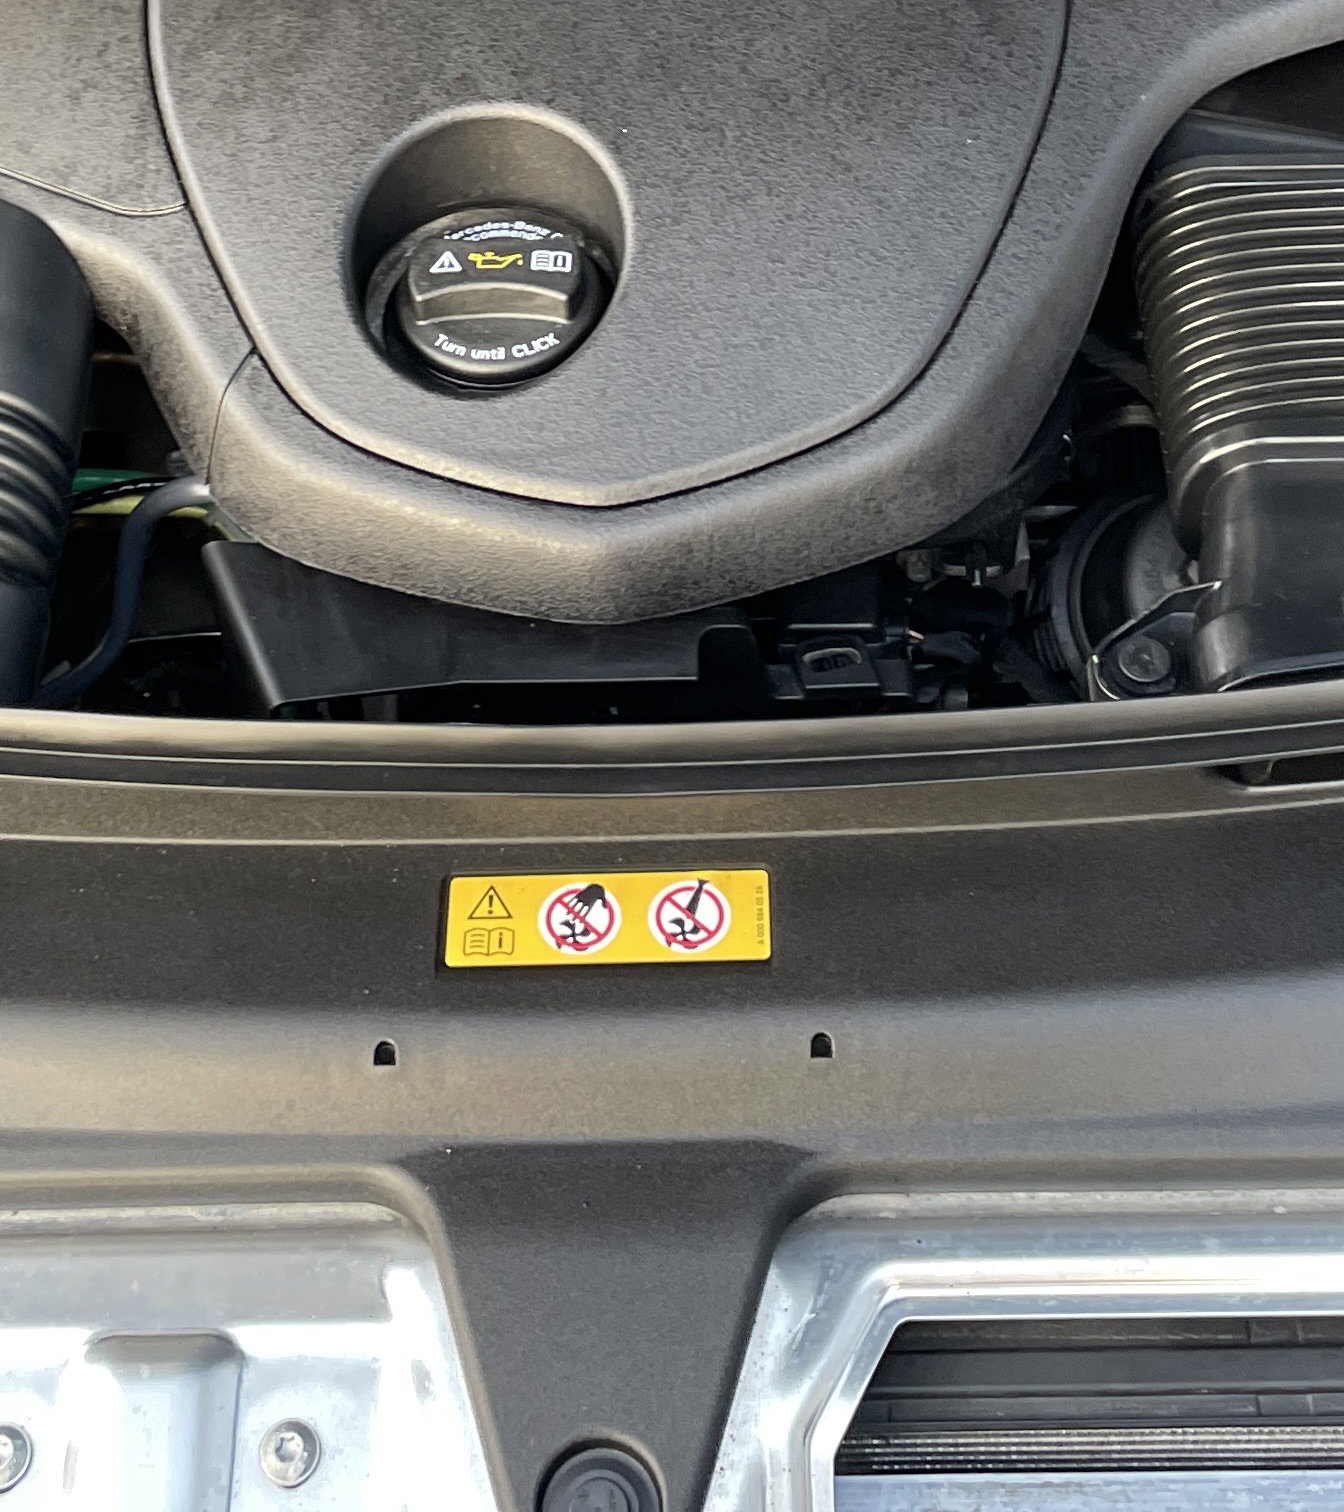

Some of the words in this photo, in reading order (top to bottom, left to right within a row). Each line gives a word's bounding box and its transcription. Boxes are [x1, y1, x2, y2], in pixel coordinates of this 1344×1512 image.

[434, 333, 467, 357] Turn
[470, 346, 506, 361] until
[511, 332, 560, 358] CLICK
